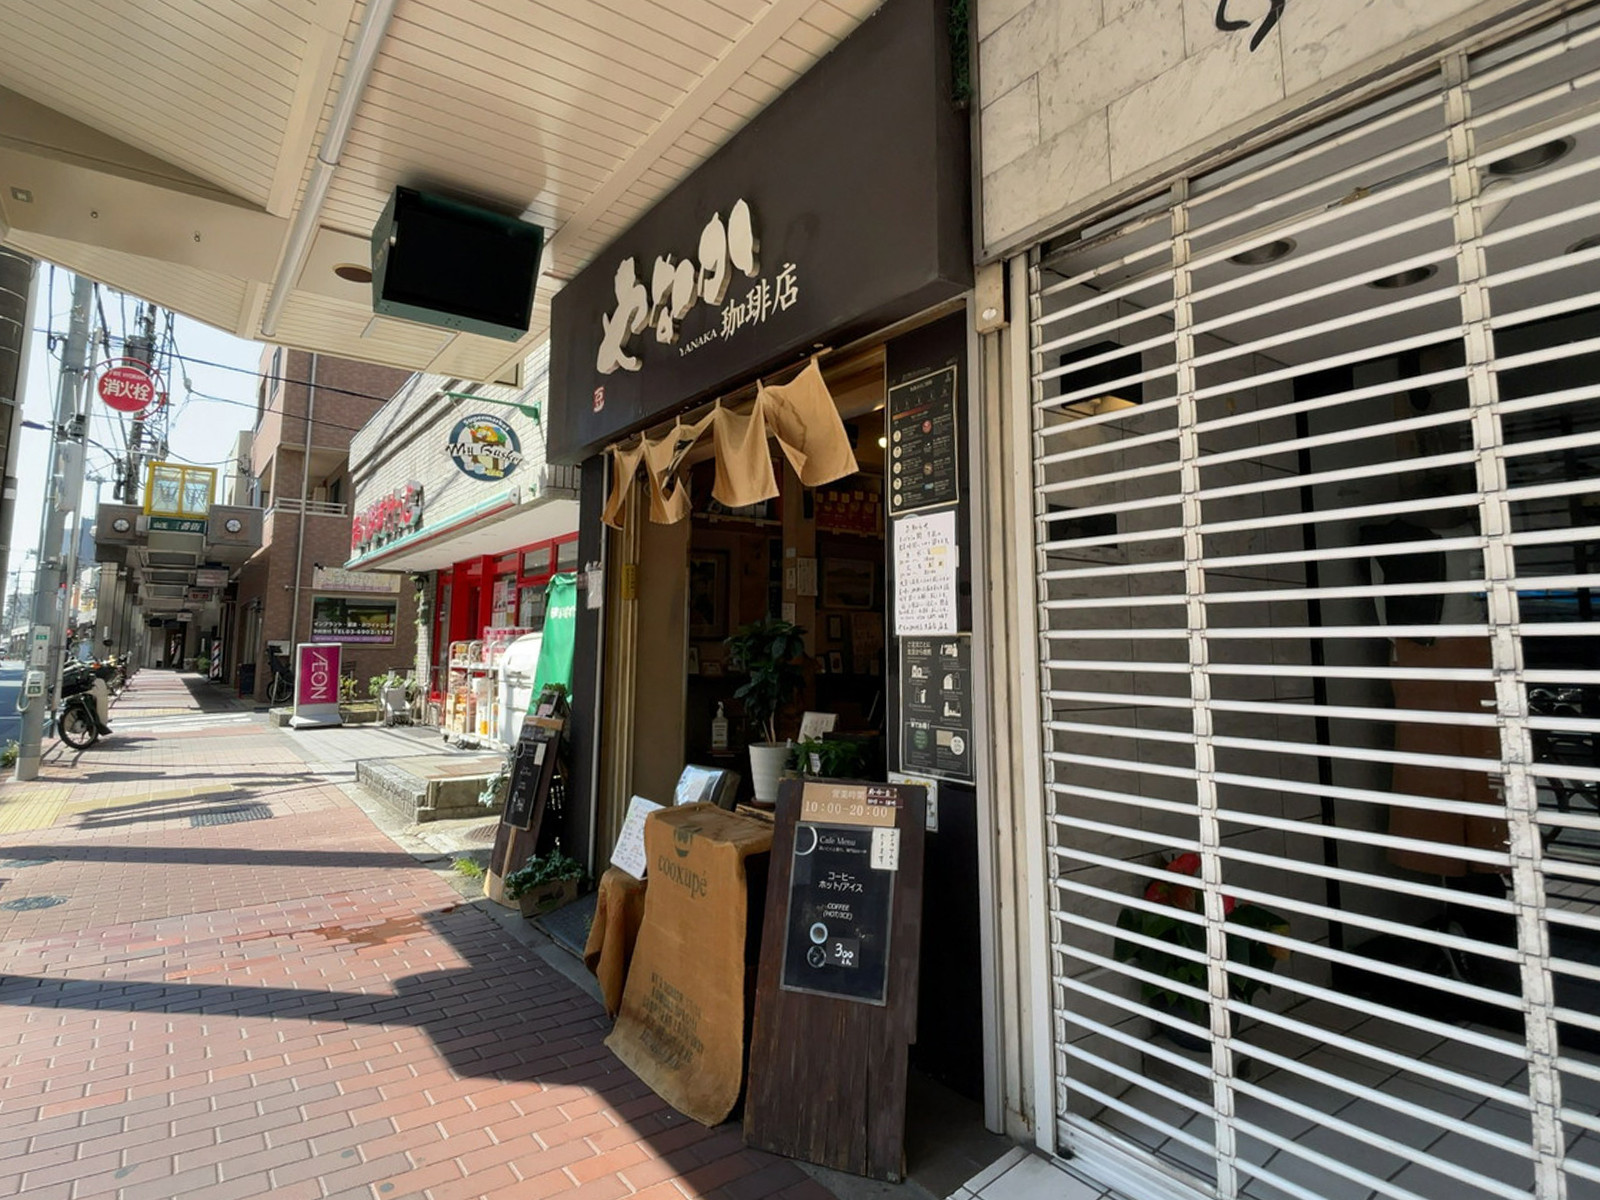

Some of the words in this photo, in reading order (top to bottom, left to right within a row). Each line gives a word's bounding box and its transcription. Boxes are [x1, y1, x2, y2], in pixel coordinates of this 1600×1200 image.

[720, 262, 799, 342] 珈琲店
[678, 328, 717, 357] YANAKA
[102, 377, 151, 402] 消火栓
[445, 443, 474, 457] My
[480, 443, 524, 466] Basket
[657, 854, 708, 899] cooxupé
[818, 880, 863, 893] ホット/アイス
[828, 871, 855, 881] コーヒー
[827, 902, 850, 911] COFFEE
[834, 942, 854, 958] 300
